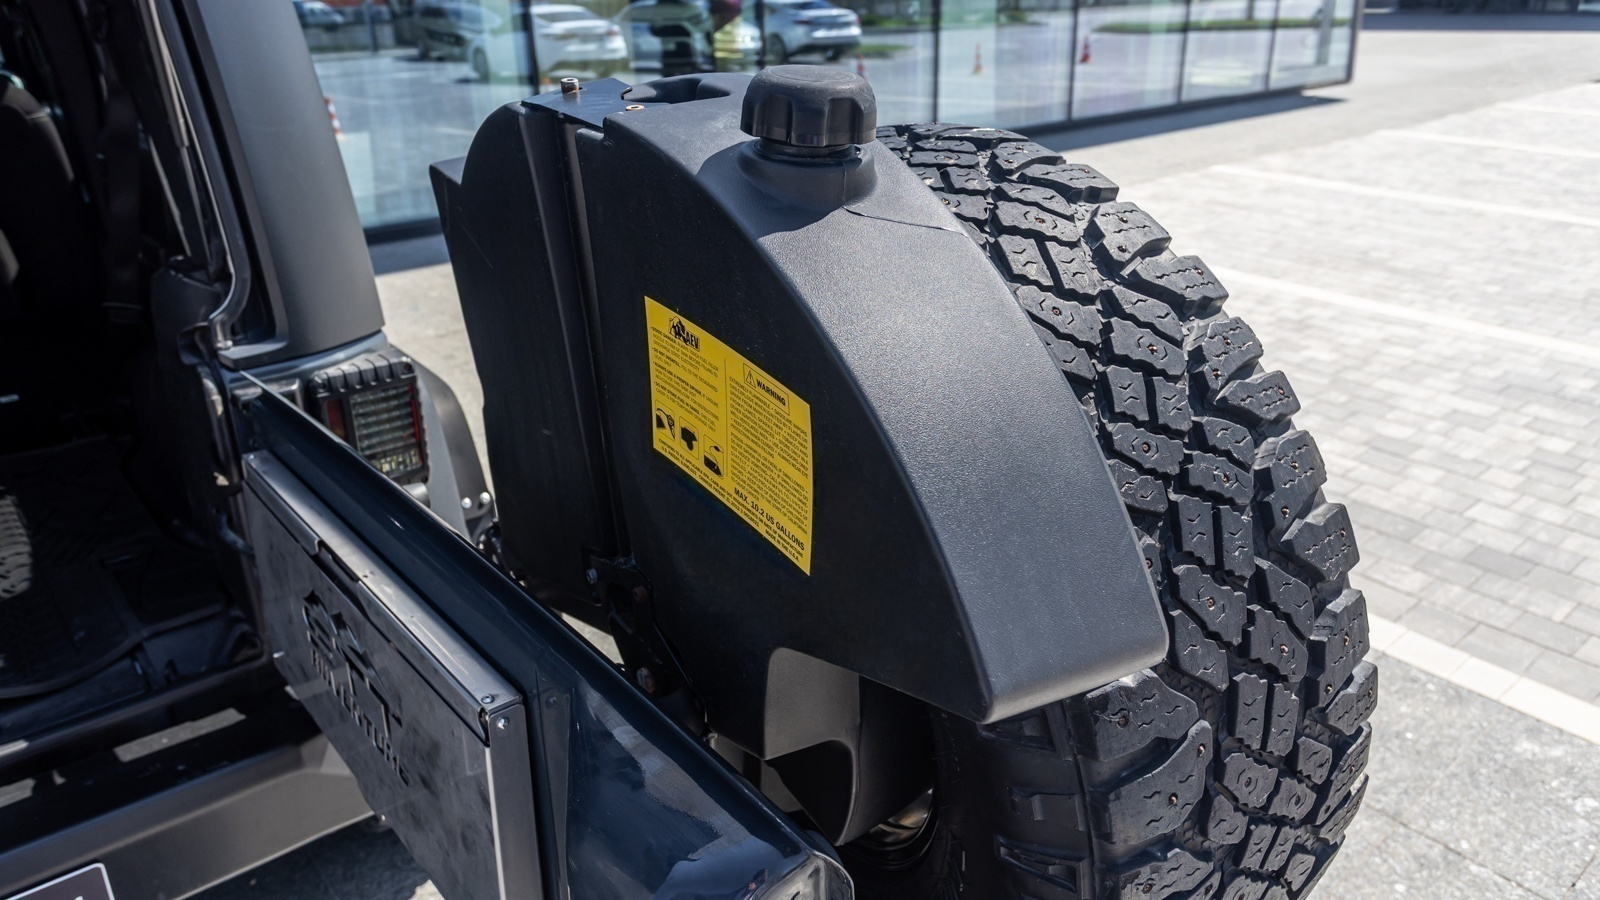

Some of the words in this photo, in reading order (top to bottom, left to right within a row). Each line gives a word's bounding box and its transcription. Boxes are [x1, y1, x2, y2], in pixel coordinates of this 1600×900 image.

[686, 332, 699, 349] AEV
[677, 377, 689, 387] PROPER
[756, 379, 786, 406] WARNING
[730, 377, 748, 393] EXTREMELY
[749, 391, 770, 409] FLAMMABLE
[775, 410, 792, 425] GASOLINE
[730, 390, 741, 401] SPARK
[742, 399, 753, 409] FROM
[764, 415, 773, 424] FEET
[788, 432, 797, 442] KEEP
[738, 389, 755, 405] EXPLODE
[755, 402, 766, 413] WHEN
[767, 411, 782, 425] IGNITED
[789, 427, 801, 439] FLAME
[730, 397, 741, 408] FROM
[782, 435, 800, 451] TOBACCO
[800, 449, 808, 458] AND
[731, 404, 741, 414] OTHER
[742, 412, 757, 426] IGNITION
[758, 424, 774, 439] SOURCES
[779, 440, 790, 451] STORE
[791, 449, 800, 458] ONLY
[734, 419, 742, 428] KEEP
[761, 440, 774, 453] CLOSED
[740, 417, 759, 434] VENTILATED
[751, 466, 763, 479] VAPOR
[764, 477, 784, 495] HARMFUL
[734, 488, 749, 505] MAX.
[751, 502, 764, 517] 10.2
[766, 514, 774, 526] US
[776, 522, 804, 550] GALLONS
[766, 529, 776, 541] MADE
